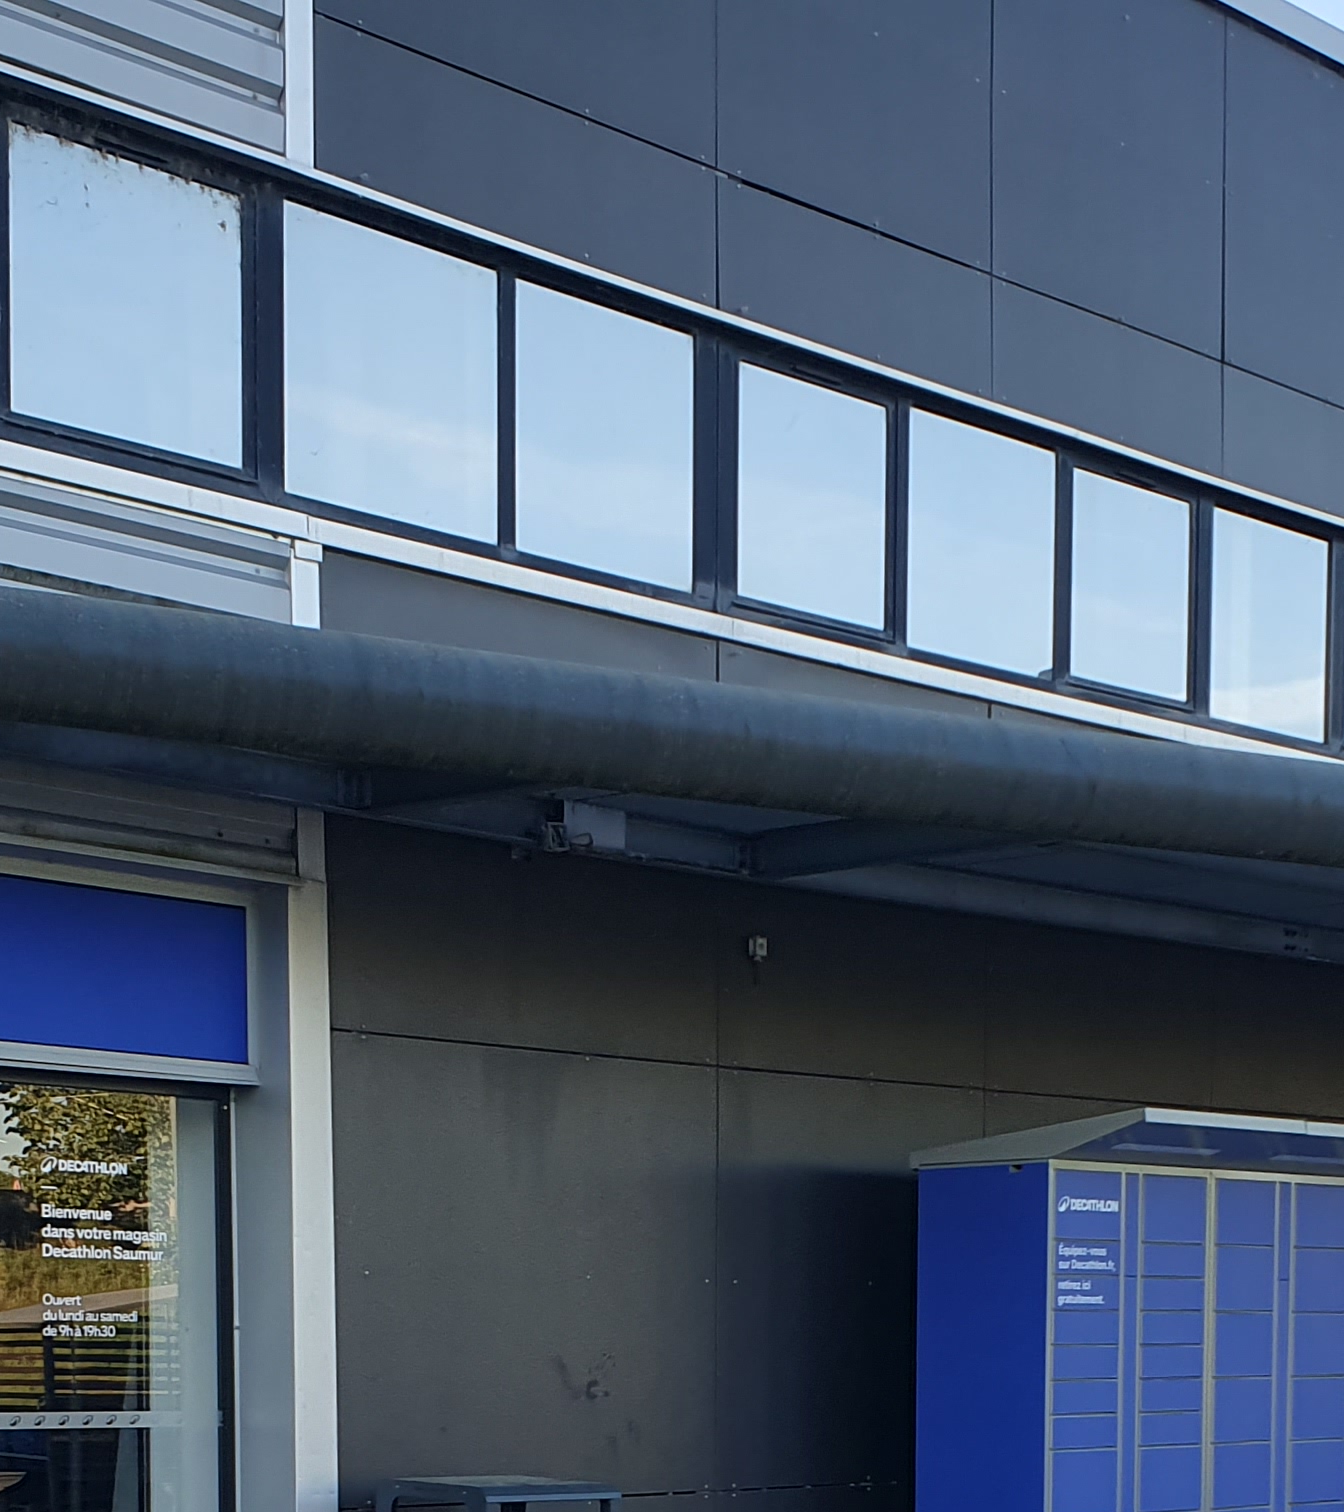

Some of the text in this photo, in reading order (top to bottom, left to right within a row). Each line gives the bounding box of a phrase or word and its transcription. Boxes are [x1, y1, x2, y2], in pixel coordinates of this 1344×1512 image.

[58, 1159, 128, 1175] DECATHLON
[41, 1203, 113, 1221] Bienvenue
[1070, 1198, 1119, 1213] DECATHLON
[41, 1223, 167, 1245] dans votre magasin
[41, 1243, 164, 1261] Decathlon Saumur
[42, 1293, 83, 1306] Ouvert
[42, 1309, 138, 1323] du lundi au samedi
[42, 1324, 116, 1338] de 9h à 19h30
